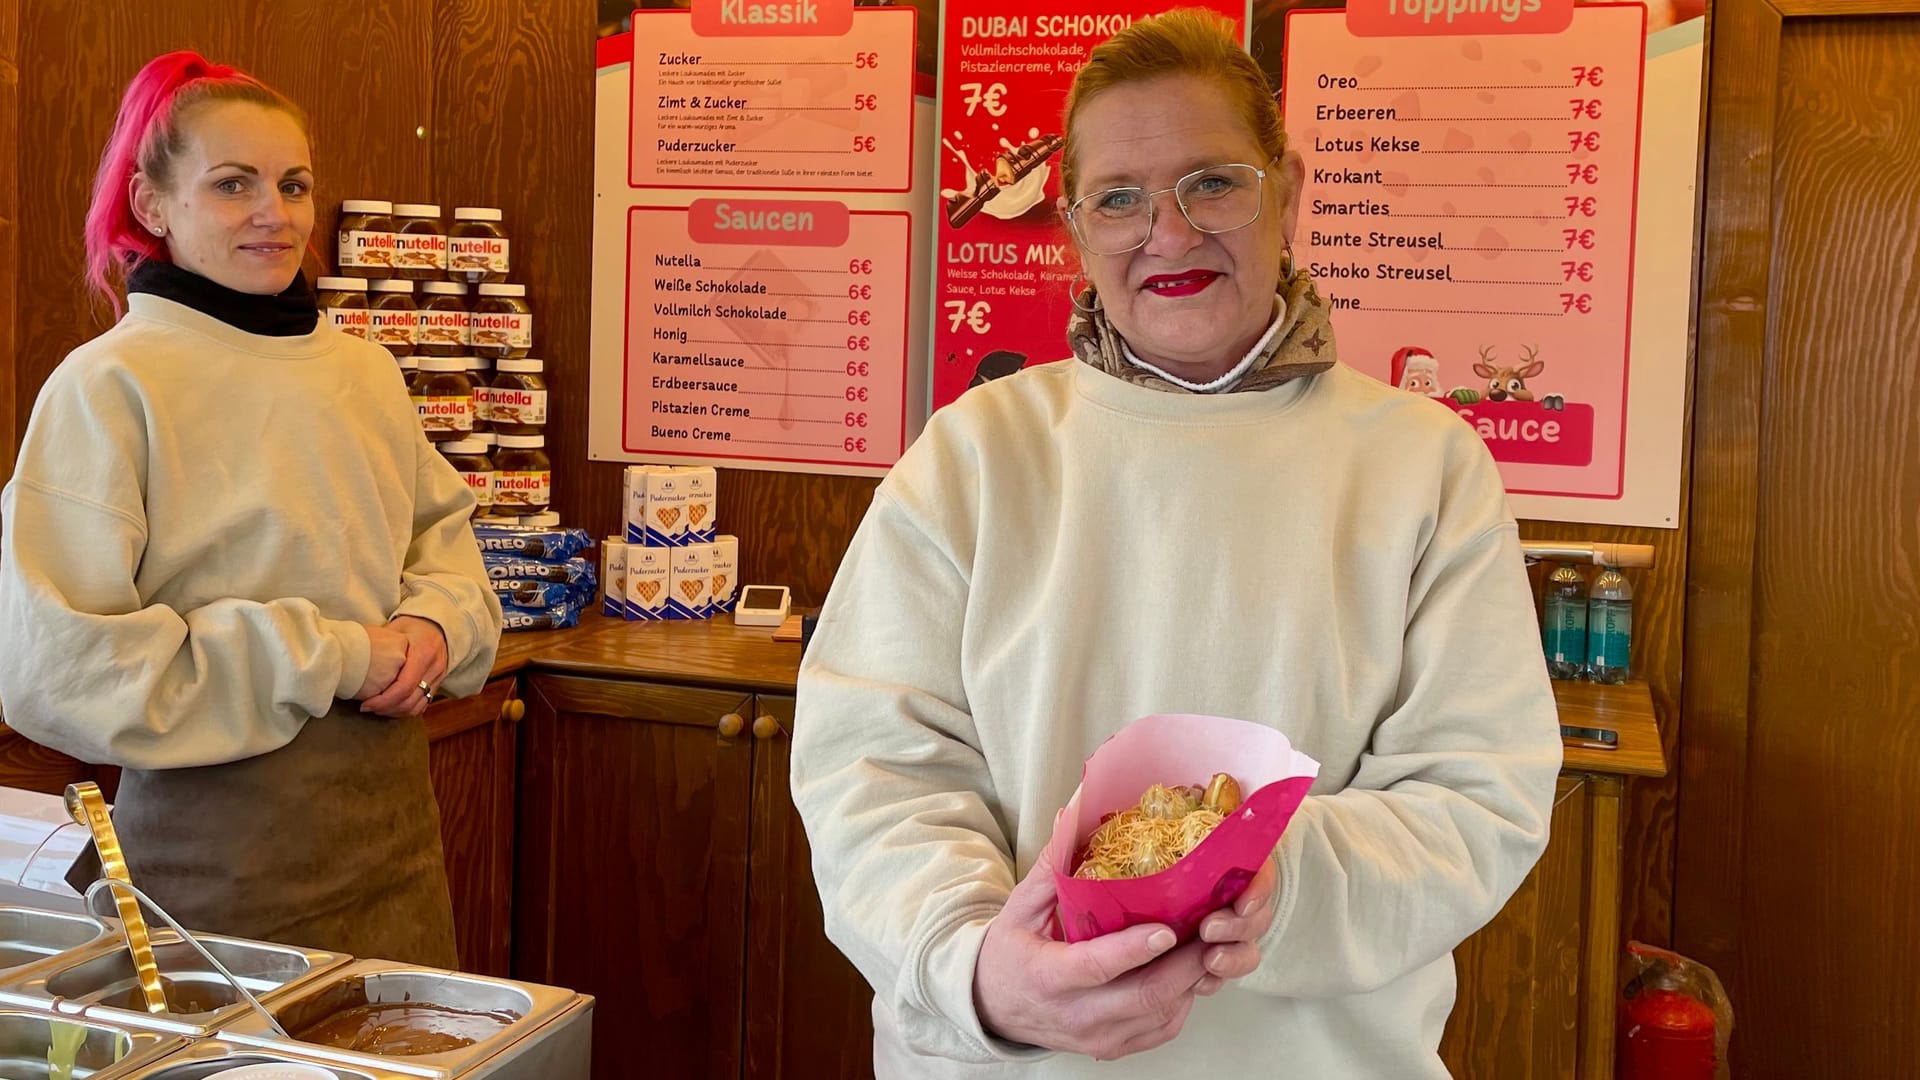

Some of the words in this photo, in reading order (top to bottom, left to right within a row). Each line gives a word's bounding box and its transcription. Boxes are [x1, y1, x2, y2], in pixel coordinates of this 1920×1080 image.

[720, 0, 819, 25] Klassik
[962, 16, 1028, 38] DUBAI
[659, 53, 702, 66] Zucker
[855, 52, 878, 69] 5€
[961, 43, 1087, 58] Vollmilchschokolade,
[960, 60, 1054, 76] Pistaziencreme,
[1318, 74, 1358, 89] Oreo
[1571, 66, 1604, 87] 7€
[658, 96, 686, 109] Zimt
[690, 96, 701, 109] &
[704, 96, 747, 109] Zucker
[854, 94, 877, 110] 5€
[960, 83, 1008, 117] 7€
[1316, 105, 1396, 121] Erbeeren
[1570, 99, 1602, 120] 7€
[658, 139, 736, 153] Puderzucker
[853, 136, 876, 153] 5€
[1315, 137, 1364, 153] Lotus
[1370, 136, 1420, 153] Kekse
[1568, 131, 1600, 152] 7€
[1313, 168, 1383, 184] Krokant
[1566, 164, 1599, 185] 7€
[713, 203, 814, 232] Saucen
[1312, 200, 1390, 216] Smarties
[1564, 196, 1597, 218] 7€
[396, 235, 446, 250] nutella
[451, 240, 502, 254] nutella
[1311, 231, 1362, 247] Bunte
[1368, 232, 1444, 249] Streusel
[1562, 229, 1596, 250] 7€
[655, 254, 701, 267] Nutella
[849, 259, 872, 275] 6€
[947, 242, 1018, 265] LOTUS
[1025, 244, 1065, 266] MIX
[947, 269, 978, 280] Weisse
[981, 269, 1037, 282] Schokolade,
[1310, 262, 1370, 279] Schoko
[1376, 264, 1452, 281] Streusel
[1561, 261, 1594, 282] 7€
[654, 278, 692, 292] Weiße
[696, 280, 766, 295] Schokolade
[849, 284, 872, 300] 6€
[946, 283, 977, 296] Sauce,
[980, 285, 1006, 295] Lotus
[1009, 286, 1036, 296] Kekse
[1560, 293, 1592, 315] 7€
[336, 312, 369, 325] nutell
[420, 313, 470, 327] nutella
[473, 316, 520, 329] nutella
[654, 304, 711, 318] Vollmilch
[716, 306, 787, 320] Schokolade
[848, 310, 870, 326] 6€
[945, 300, 991, 334] 7€
[653, 328, 688, 344] Honig
[847, 336, 870, 351] 6€
[652, 352, 744, 368] Karamellsauce
[846, 361, 869, 377] 6€
[490, 392, 532, 405] nutella
[652, 376, 738, 392] Erdbeersauce
[846, 386, 868, 402] 6€
[418, 403, 465, 414] nutella
[711, 404, 750, 418] Creme
[845, 412, 868, 428] 6€
[651, 426, 688, 440] Bueno
[692, 427, 731, 442] Creme
[844, 437, 867, 453] 6€
[495, 478, 540, 489] nutella
[487, 566, 550, 579] OREO
